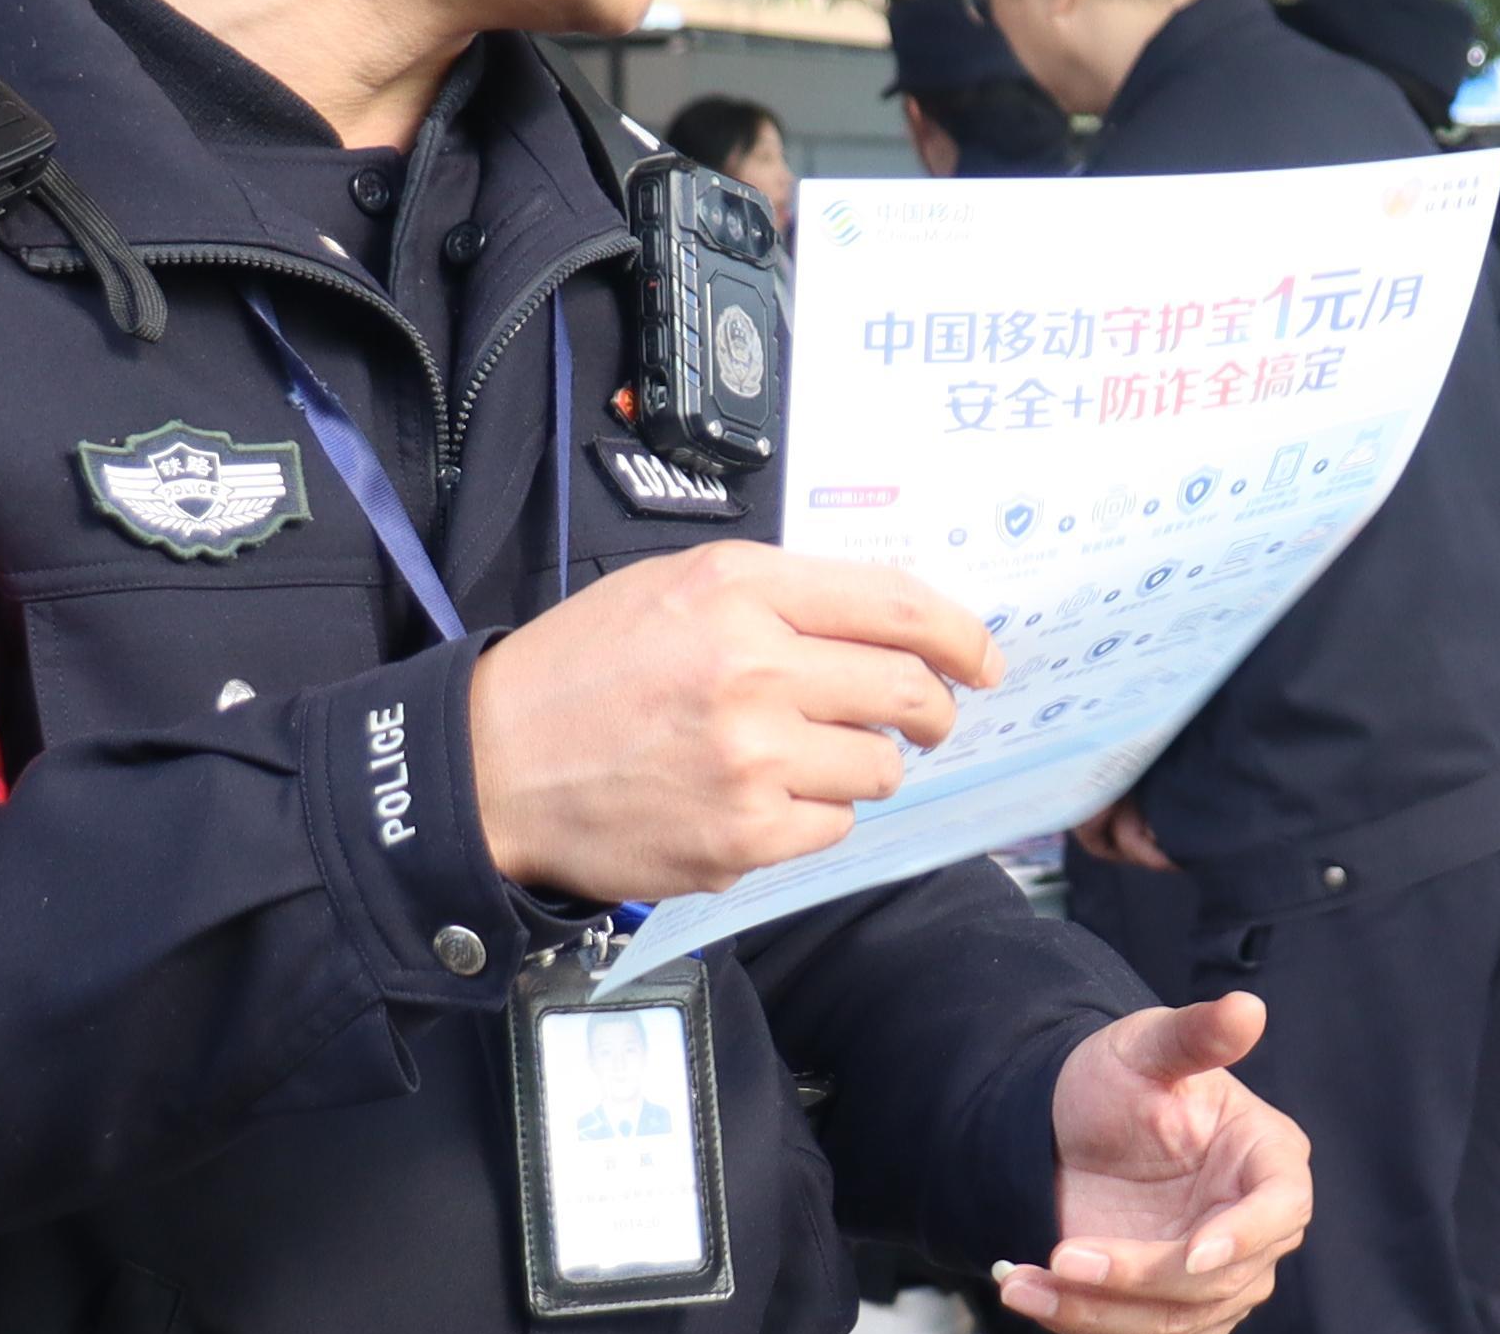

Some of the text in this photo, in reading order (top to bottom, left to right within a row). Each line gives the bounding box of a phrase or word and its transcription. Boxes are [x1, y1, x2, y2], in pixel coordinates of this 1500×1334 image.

[943, 345, 1346, 434] 安全+防诈全搞定
[159, 456, 213, 476] 铁路
[164, 483, 220, 496] POLICE
[368, 702, 416, 847] POLICE
